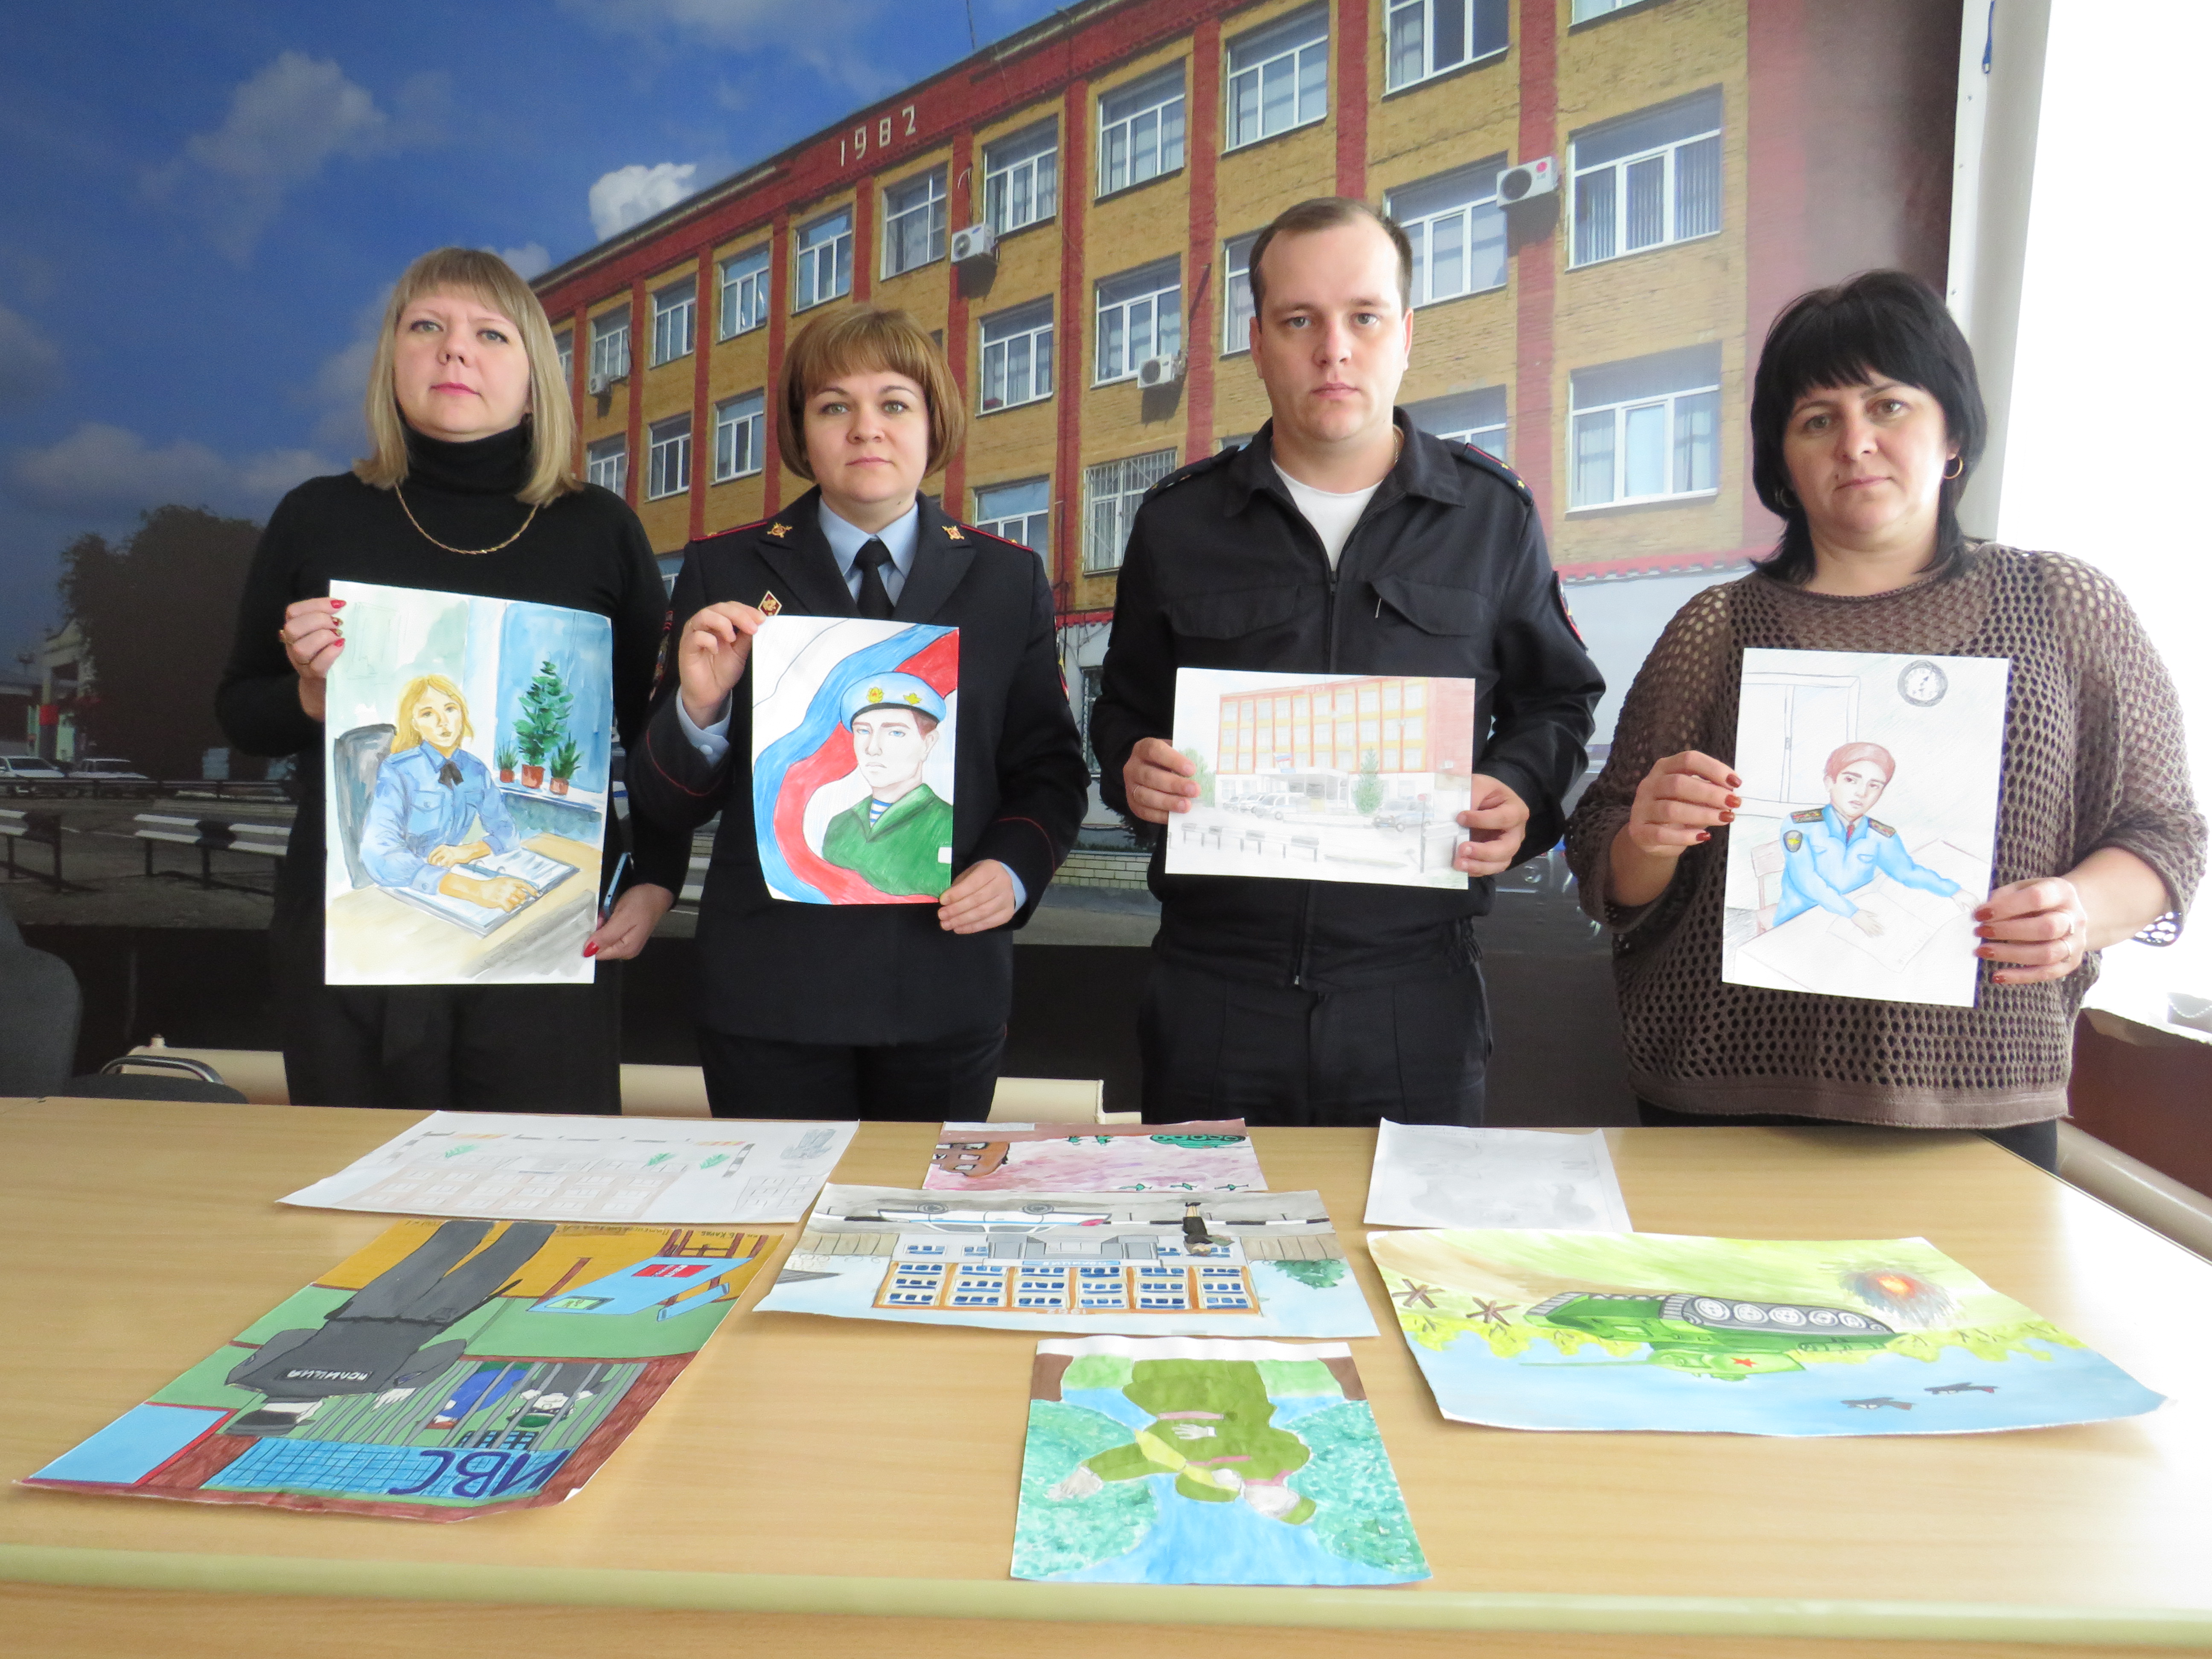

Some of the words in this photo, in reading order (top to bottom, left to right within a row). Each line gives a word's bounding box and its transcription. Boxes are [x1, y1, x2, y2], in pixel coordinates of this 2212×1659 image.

[841, 105, 916, 166] 1982
[287, 1369, 369, 1381] ПОЛИЦИЯ
[388, 1449, 570, 1498] ИВС
